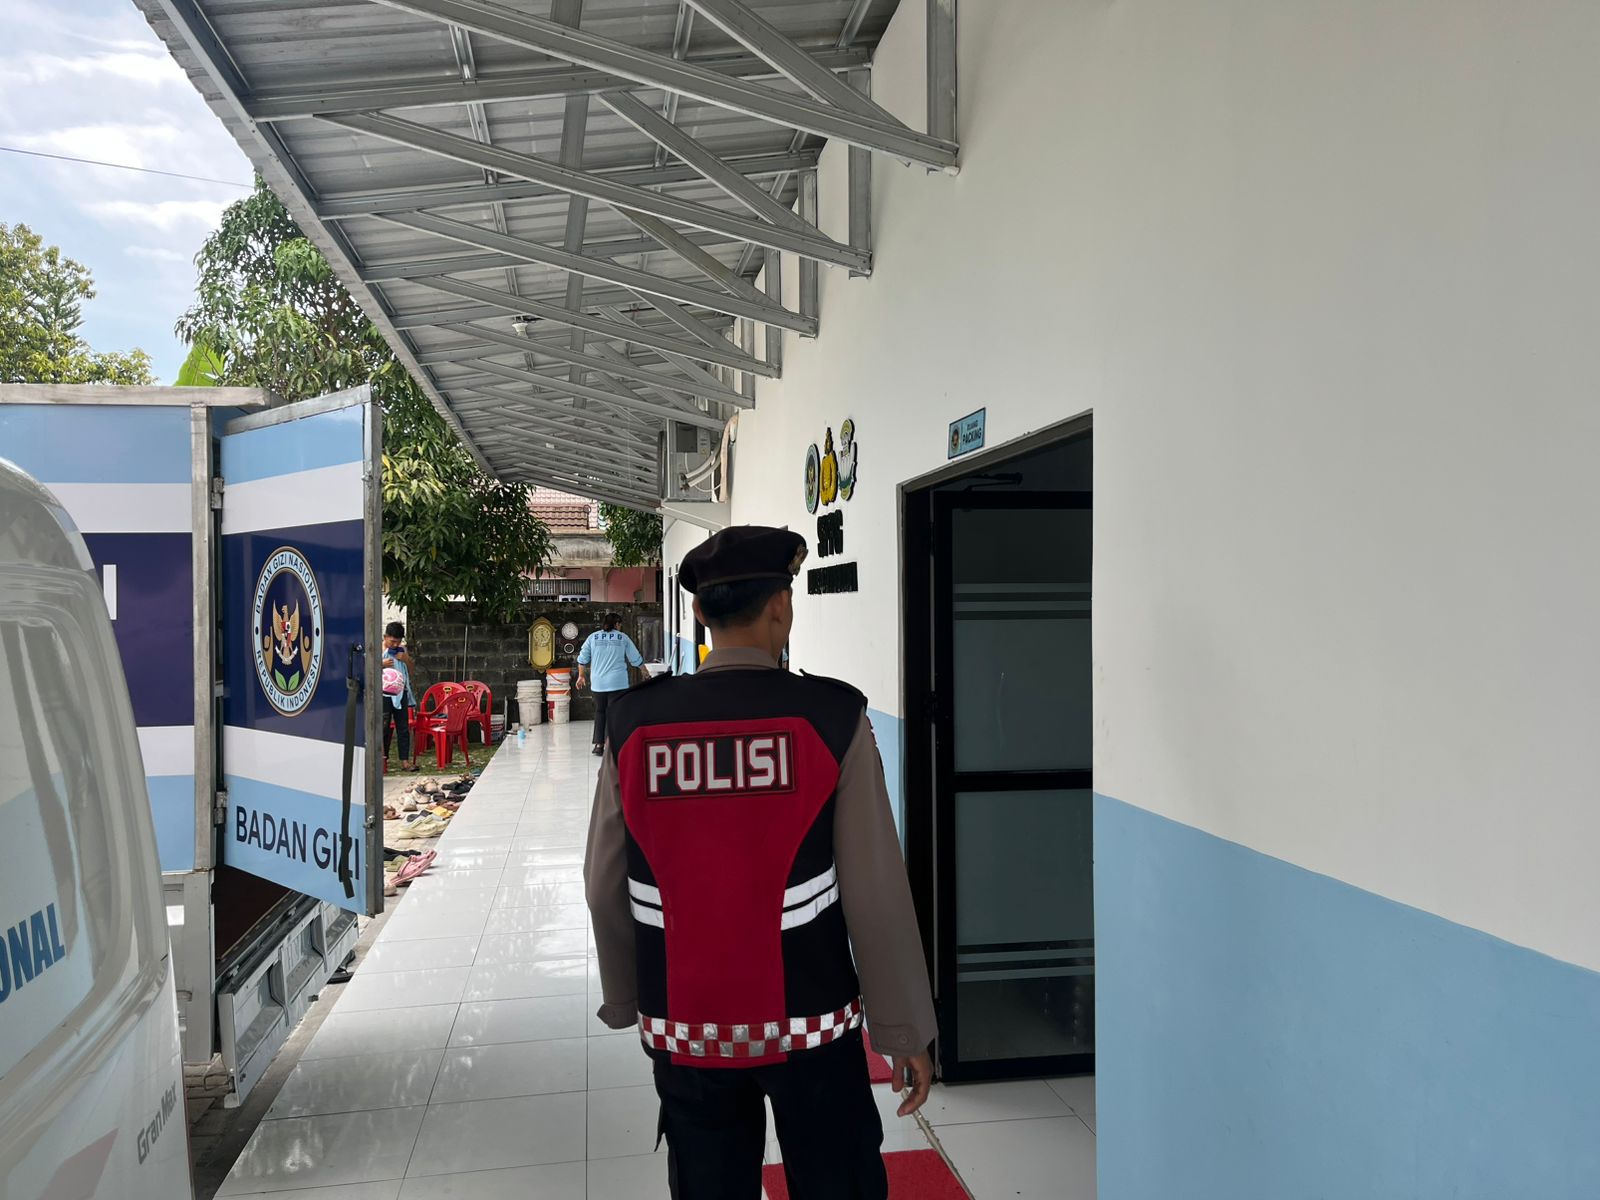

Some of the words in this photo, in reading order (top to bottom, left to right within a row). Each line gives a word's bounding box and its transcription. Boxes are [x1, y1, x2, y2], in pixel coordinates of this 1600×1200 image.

[962, 427, 982, 444] PACKING
[255, 567, 273, 615] BADAN
[272, 553, 287, 570] GIZI
[288, 554, 319, 616] NASIONAL
[256, 649, 285, 709] REPUBLIK
[286, 654, 320, 710] INDONESIA
[648, 737, 788, 793] POLISI
[236, 805, 307, 863] BADAN
[137, 1111, 163, 1165] Gran
[161, 1080, 177, 1126] Max
